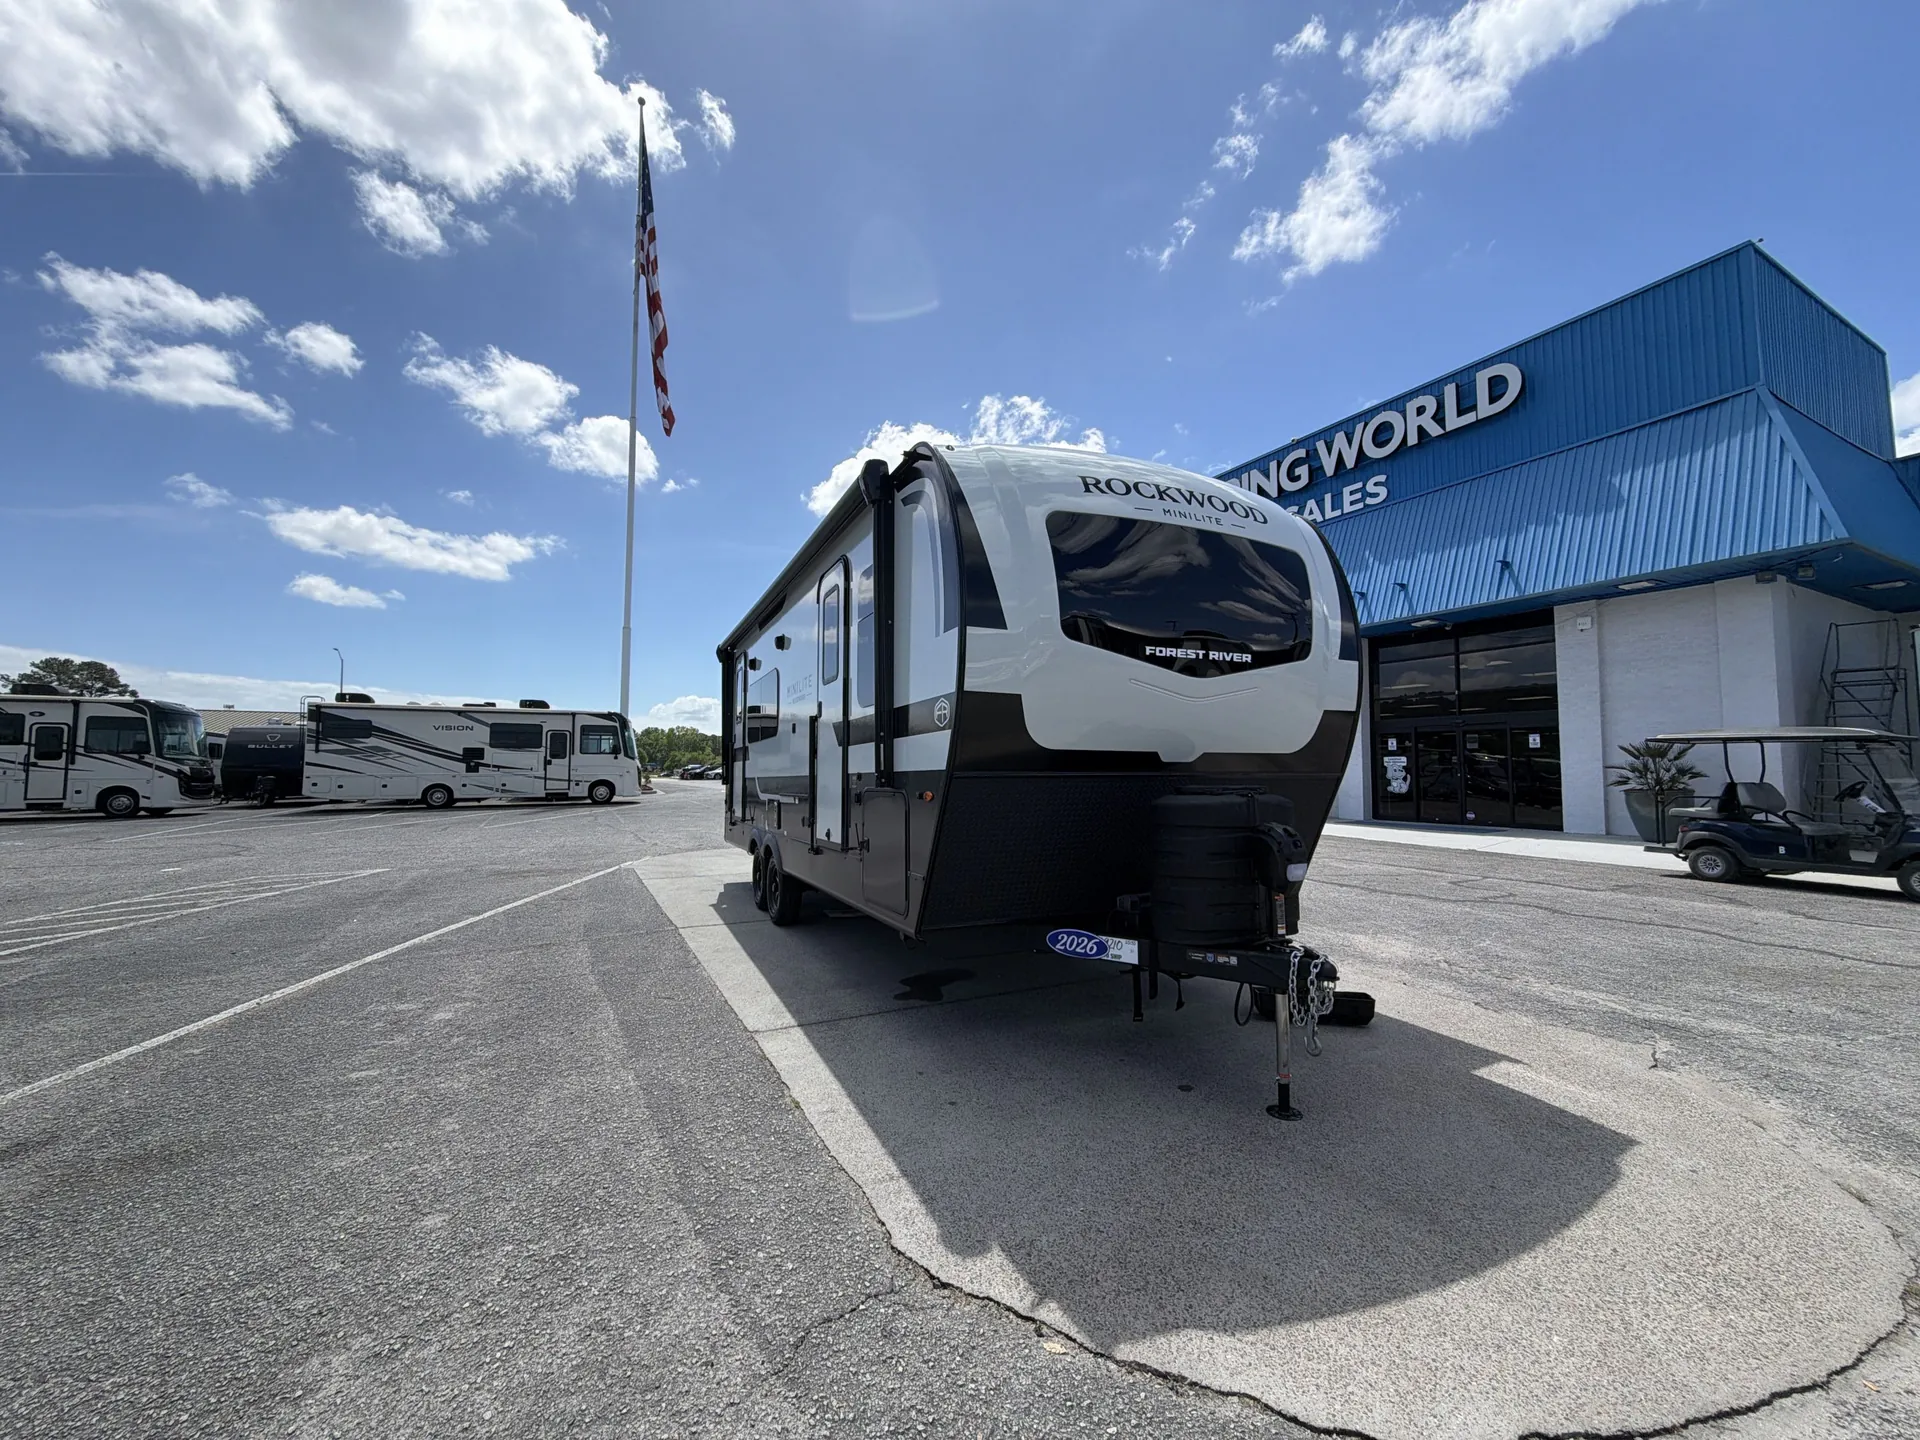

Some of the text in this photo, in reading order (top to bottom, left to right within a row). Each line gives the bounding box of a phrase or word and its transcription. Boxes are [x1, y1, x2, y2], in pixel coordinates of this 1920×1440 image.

[1315, 362, 1523, 478] WORLD
[1078, 475, 1268, 525] ROCKWOOD
[1162, 508, 1223, 526] MINILITE
[1145, 646, 1252, 663] FOREST RIVER
[1778, 845, 1786, 854] B
[1055, 933, 1098, 955] 2026
